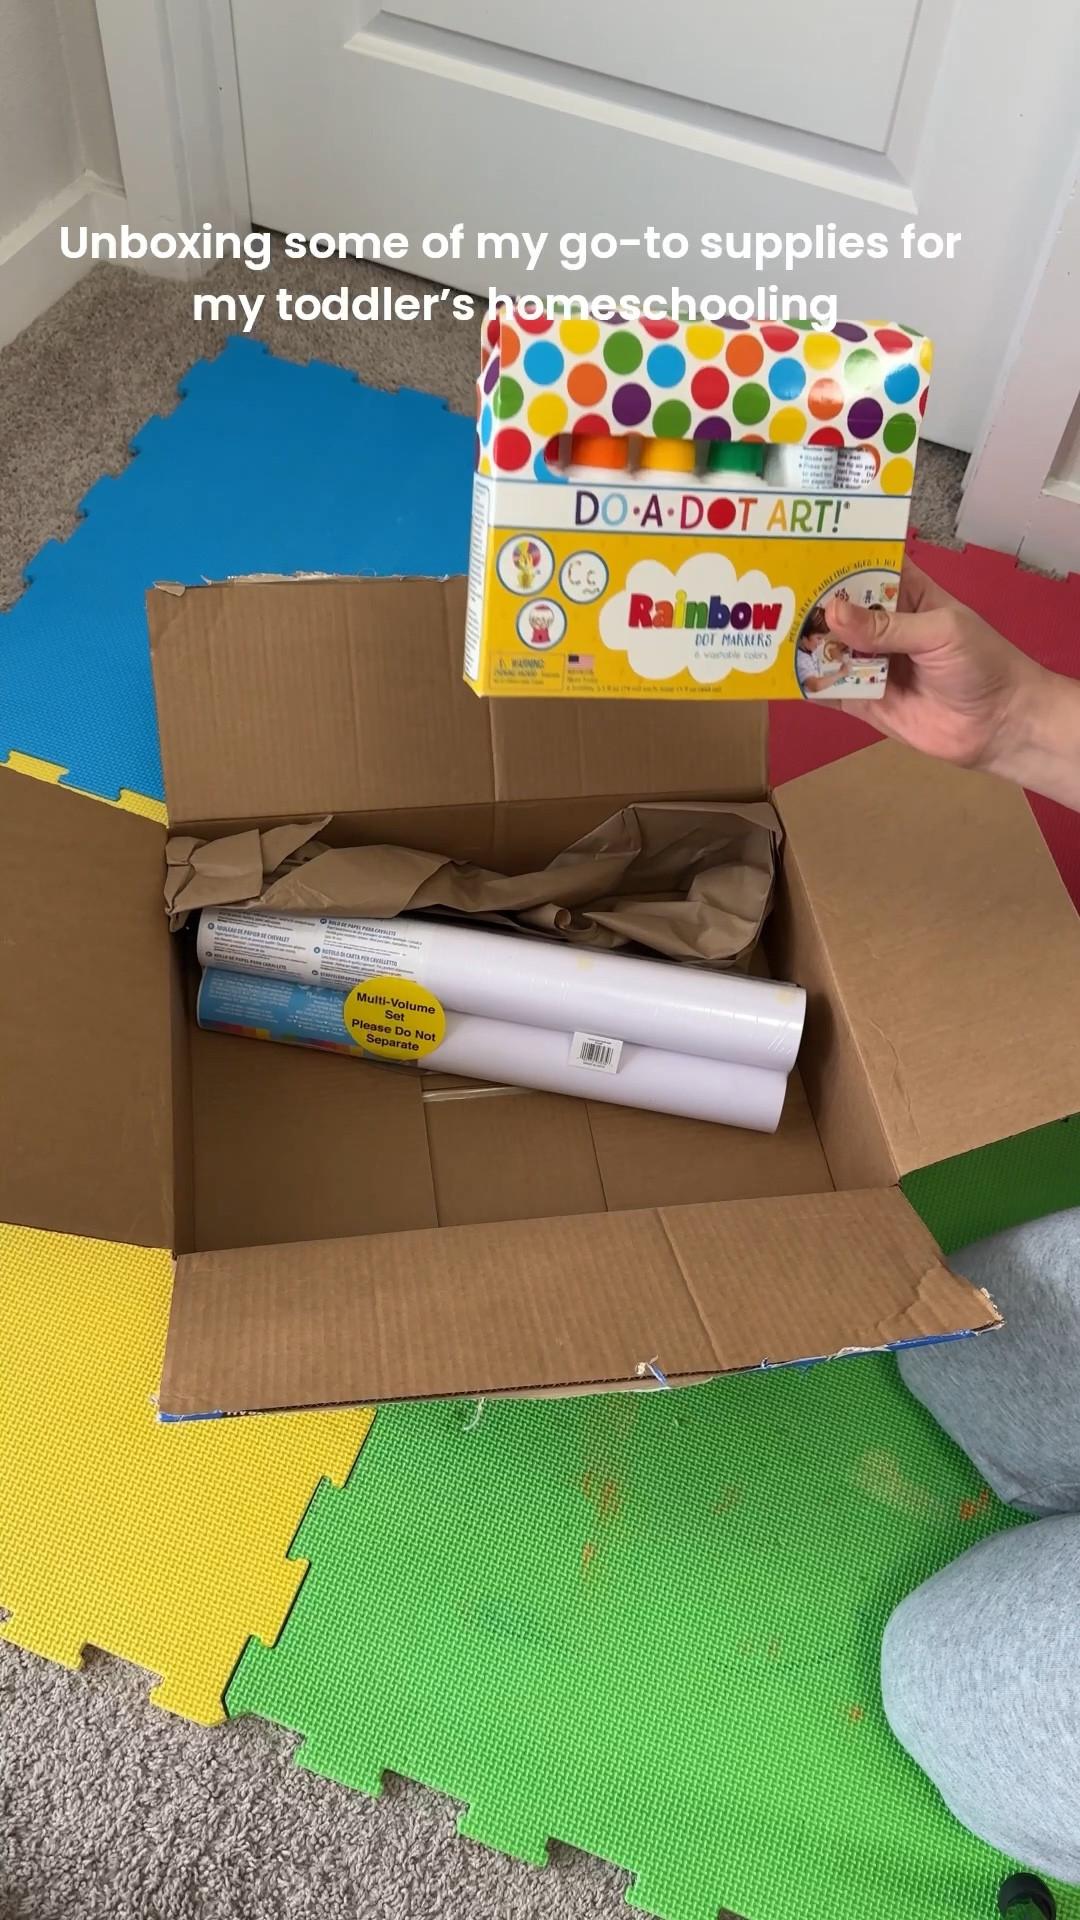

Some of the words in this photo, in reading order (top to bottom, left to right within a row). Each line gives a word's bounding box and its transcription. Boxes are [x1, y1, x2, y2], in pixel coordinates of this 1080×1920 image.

[628, 589, 783, 631] Rainbow
[695, 633, 716, 647] DOT
[721, 632, 772, 648] MARKERS
[356, 992, 436, 1014] Multi-Volume
[385, 1010, 405, 1022] Set
[351, 1019, 392, 1034] Please
[395, 1026, 412, 1037] Do
[415, 1030, 436, 1042] Not
[366, 1033, 420, 1051] Separate
